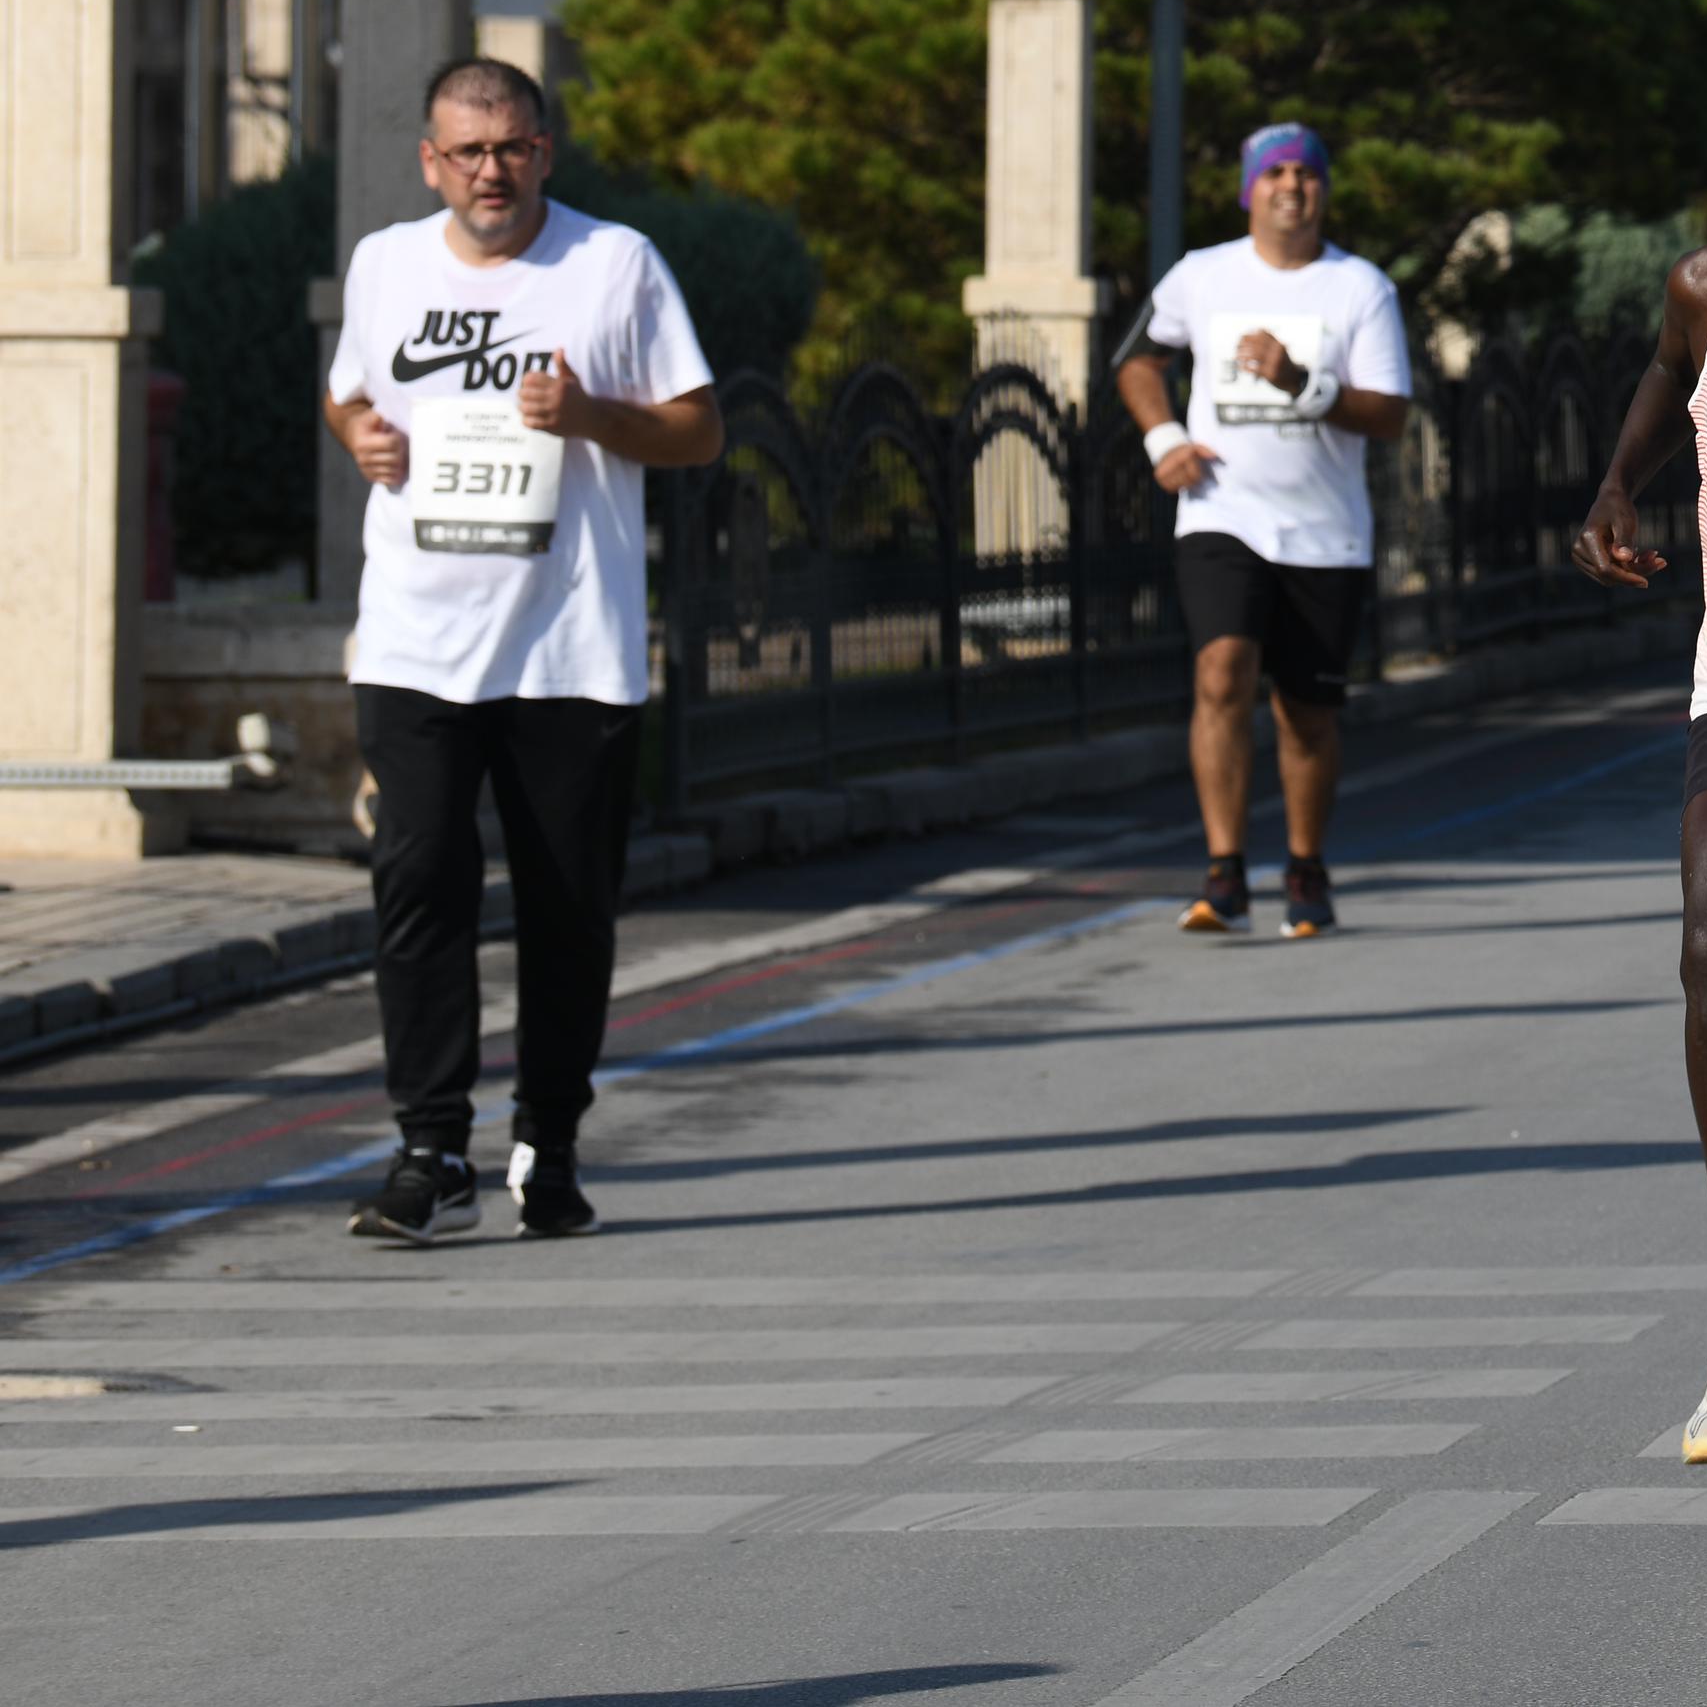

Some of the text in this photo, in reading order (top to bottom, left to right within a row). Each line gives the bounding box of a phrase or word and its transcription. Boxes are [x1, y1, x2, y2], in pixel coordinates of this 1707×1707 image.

[413, 310, 501, 349] JUST
[463, 353, 517, 390] DO
[433, 462, 532, 495] 3311
